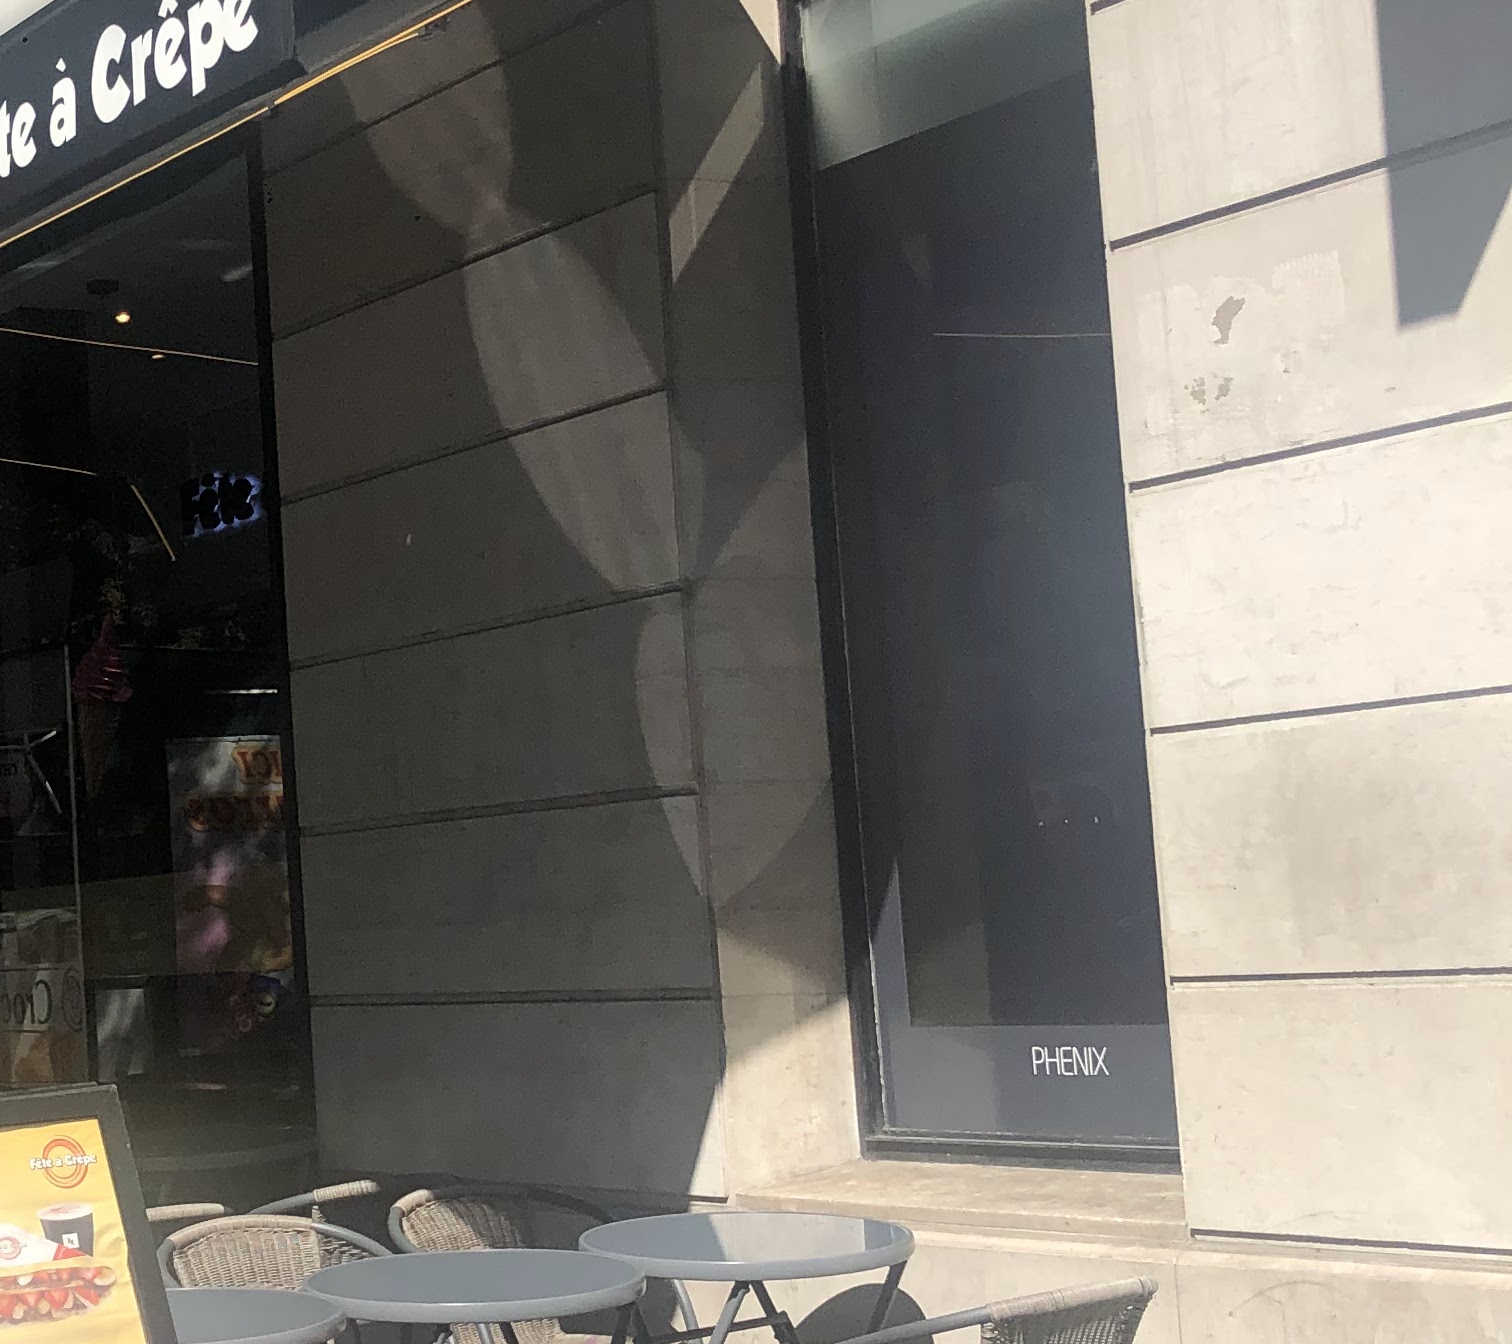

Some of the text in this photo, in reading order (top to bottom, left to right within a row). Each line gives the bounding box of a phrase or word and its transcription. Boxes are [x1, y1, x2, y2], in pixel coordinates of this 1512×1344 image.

[49, 57, 76, 148] à
[1032, 1046, 1108, 1076] PHENIX
[29, 1157, 54, 1170] Fête
[55, 1156, 63, 1167] à
